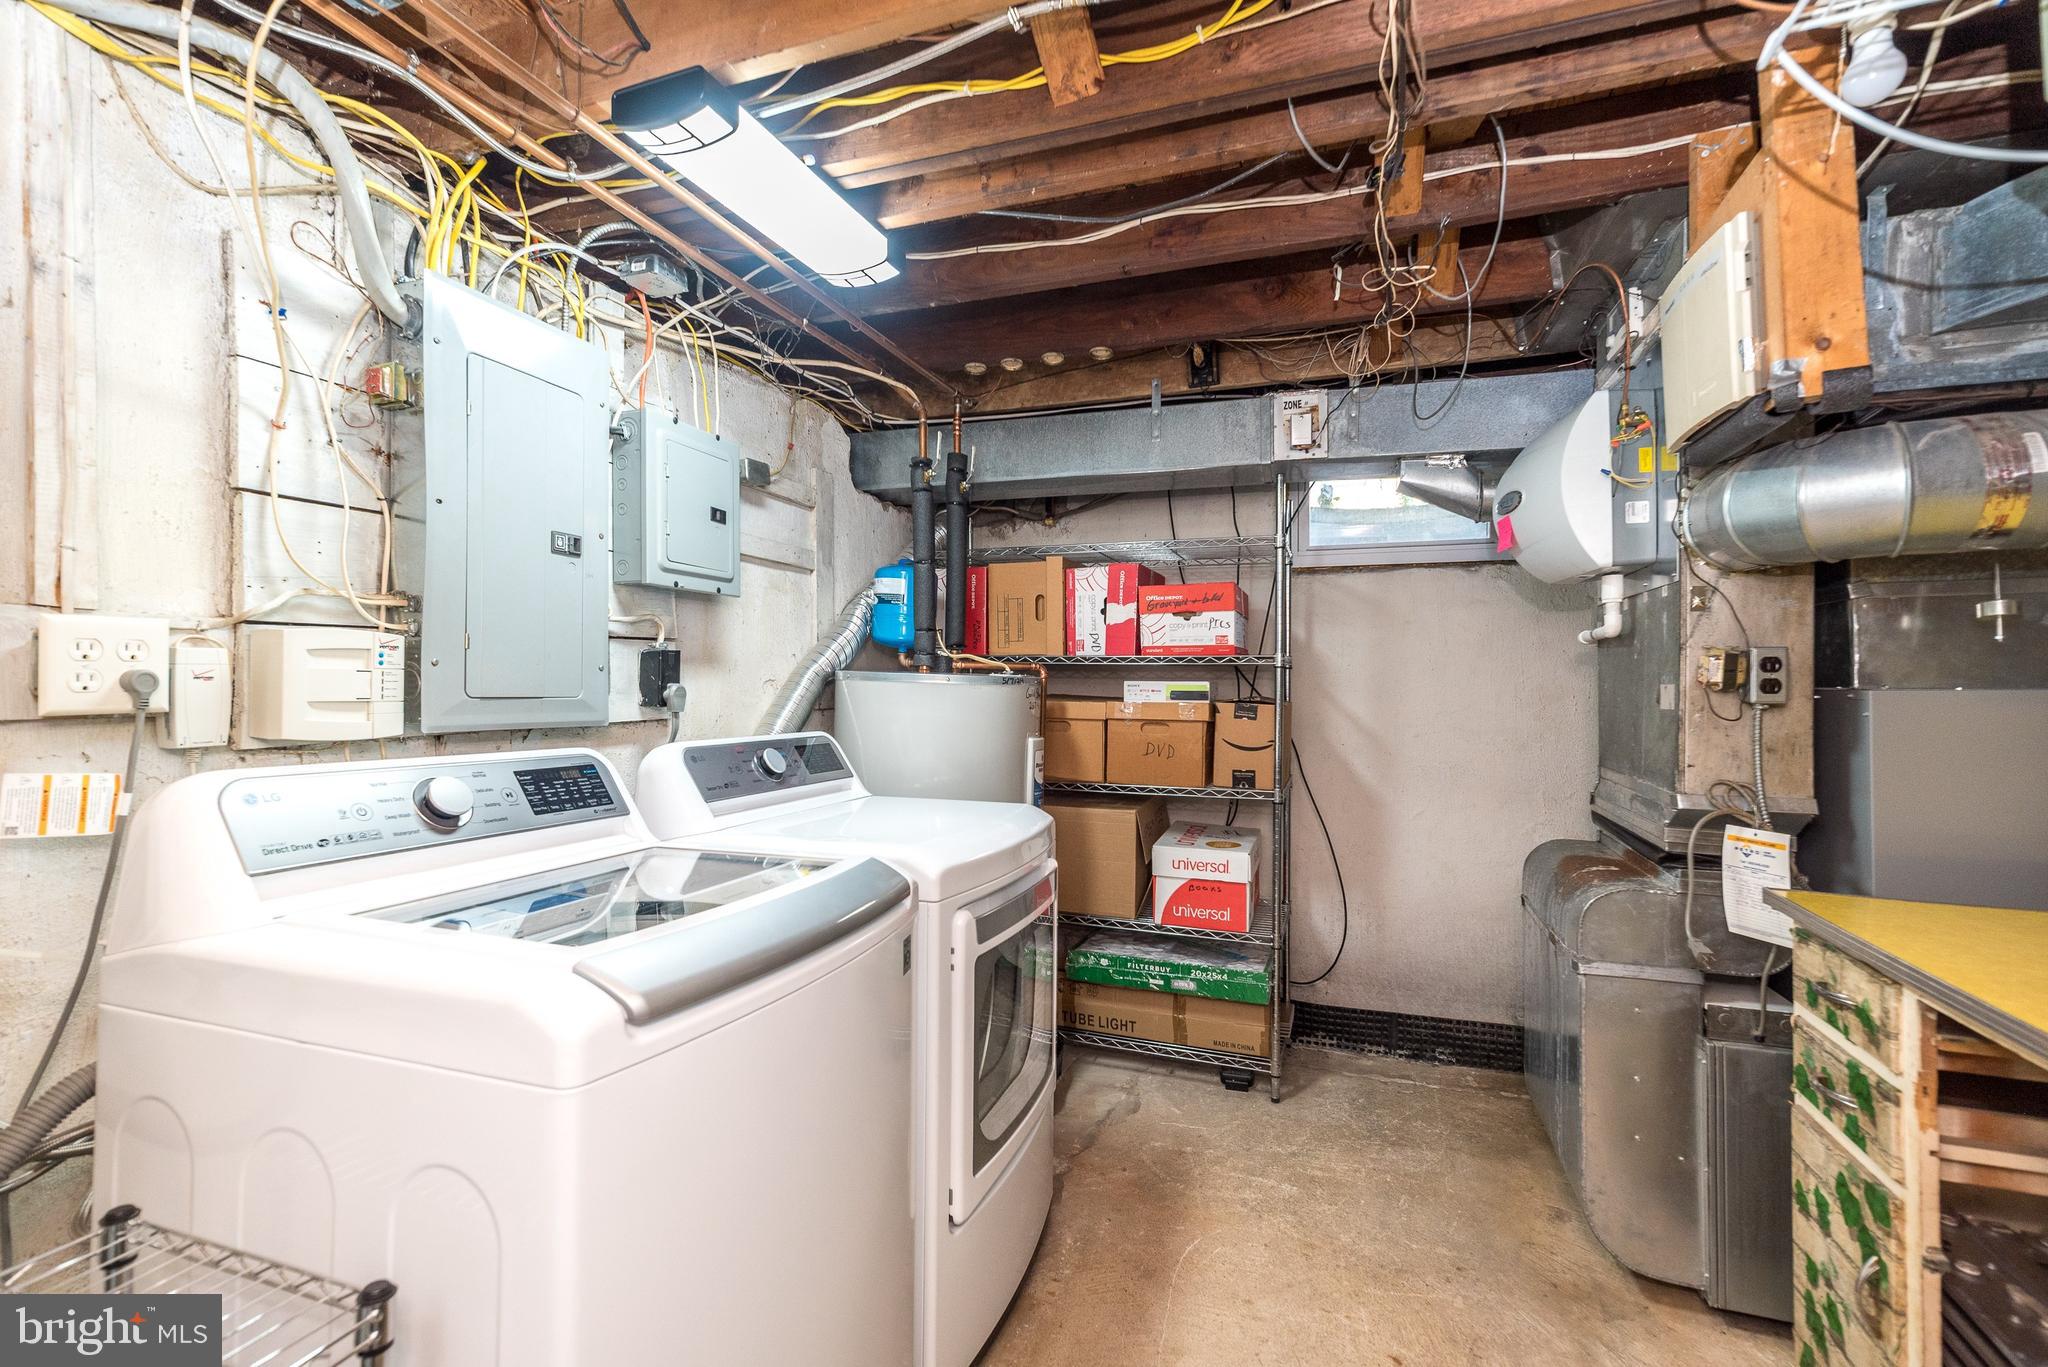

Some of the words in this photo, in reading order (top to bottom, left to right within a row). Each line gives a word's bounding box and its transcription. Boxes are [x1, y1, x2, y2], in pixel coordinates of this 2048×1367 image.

[1283, 400, 1303, 410] ZONE
[1144, 742, 1175, 760] DVD
[262, 792, 281, 803] LG
[262, 845, 290, 857] Direct
[291, 841, 314, 853] Drive
[1172, 858, 1229, 874] universal
[1173, 904, 1231, 922] universal
[1127, 961, 1171, 974] FILTERBUY
[1190, 969, 1228, 981] 20x25x4
[1062, 1010, 1095, 1027] TUBE
[1098, 1017, 1137, 1033] LIGHT
[1213, 1040, 1229, 1048] MADE
[1237, 1043, 1255, 1051] CHINA
